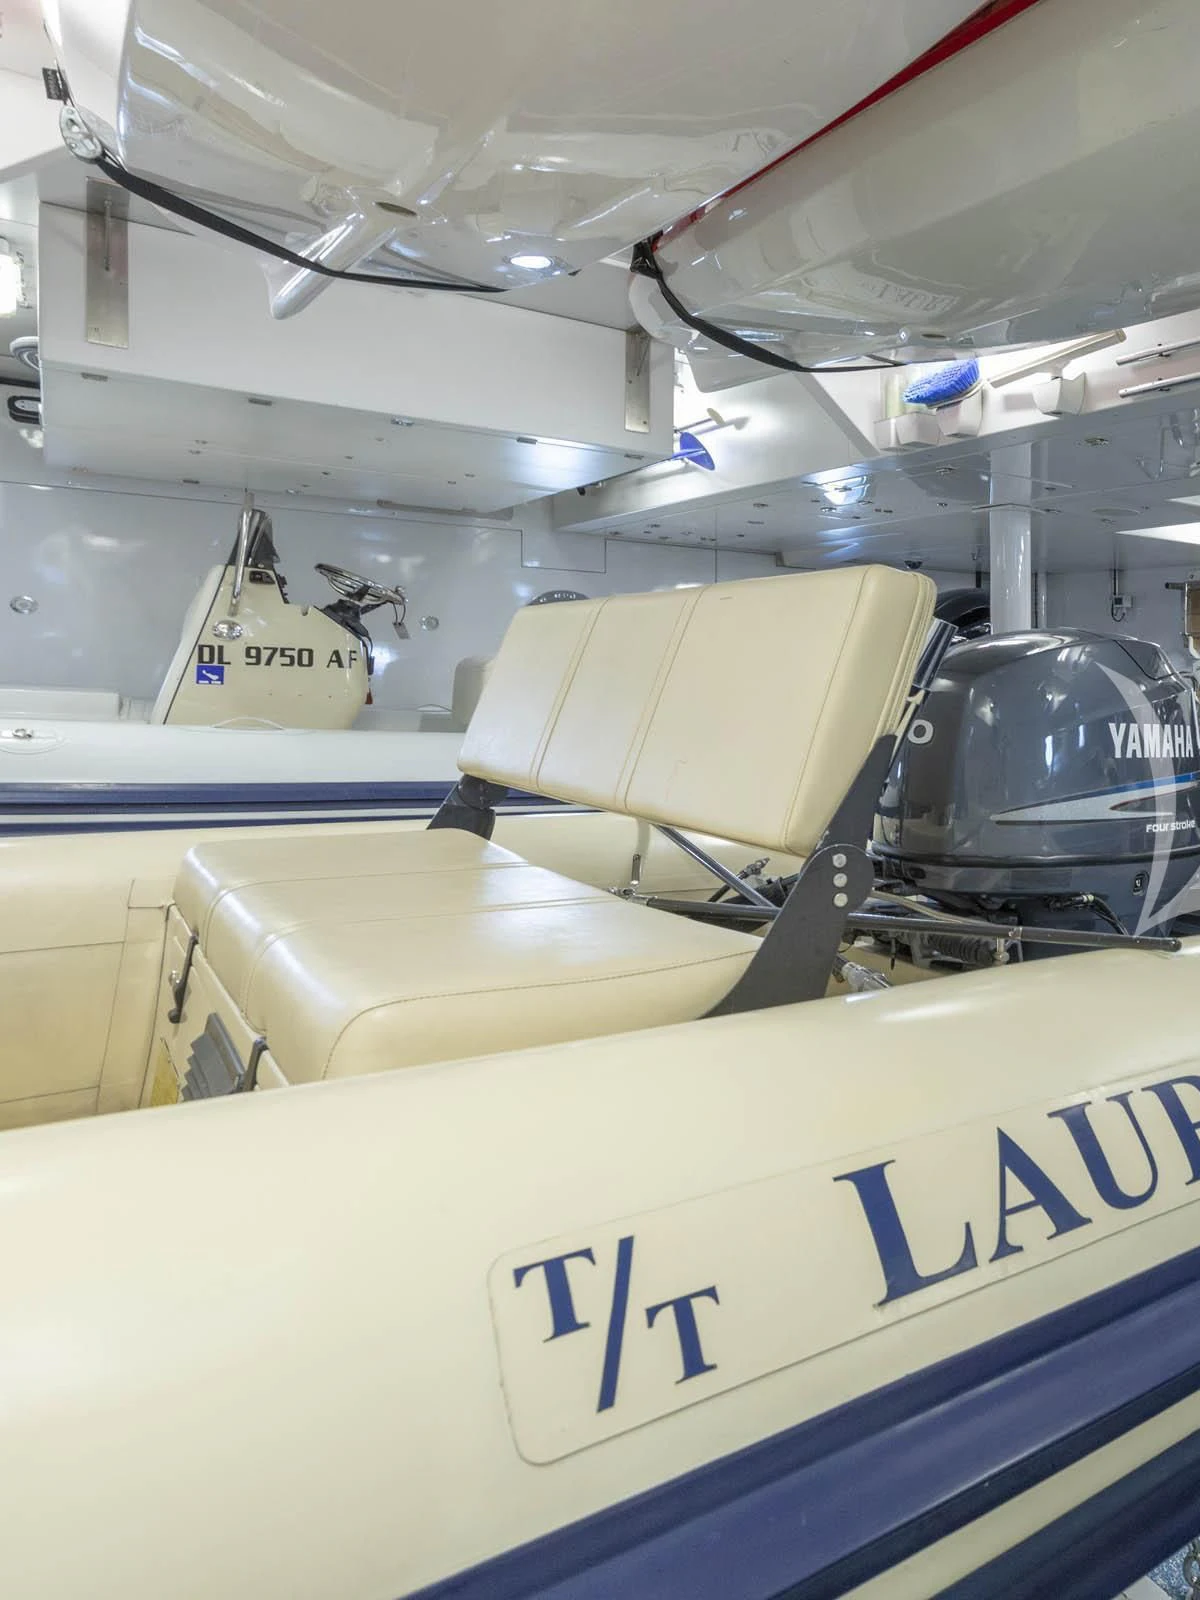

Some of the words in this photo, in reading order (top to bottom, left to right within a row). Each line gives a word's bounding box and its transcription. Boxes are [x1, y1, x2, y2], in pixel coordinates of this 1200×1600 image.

[198, 645, 231, 665] DL
[245, 646, 314, 667] 9750
[326, 649, 357, 668] AF
[1108, 723, 1194, 758] YAMAHA
[513, 1235, 720, 1413] T/T
